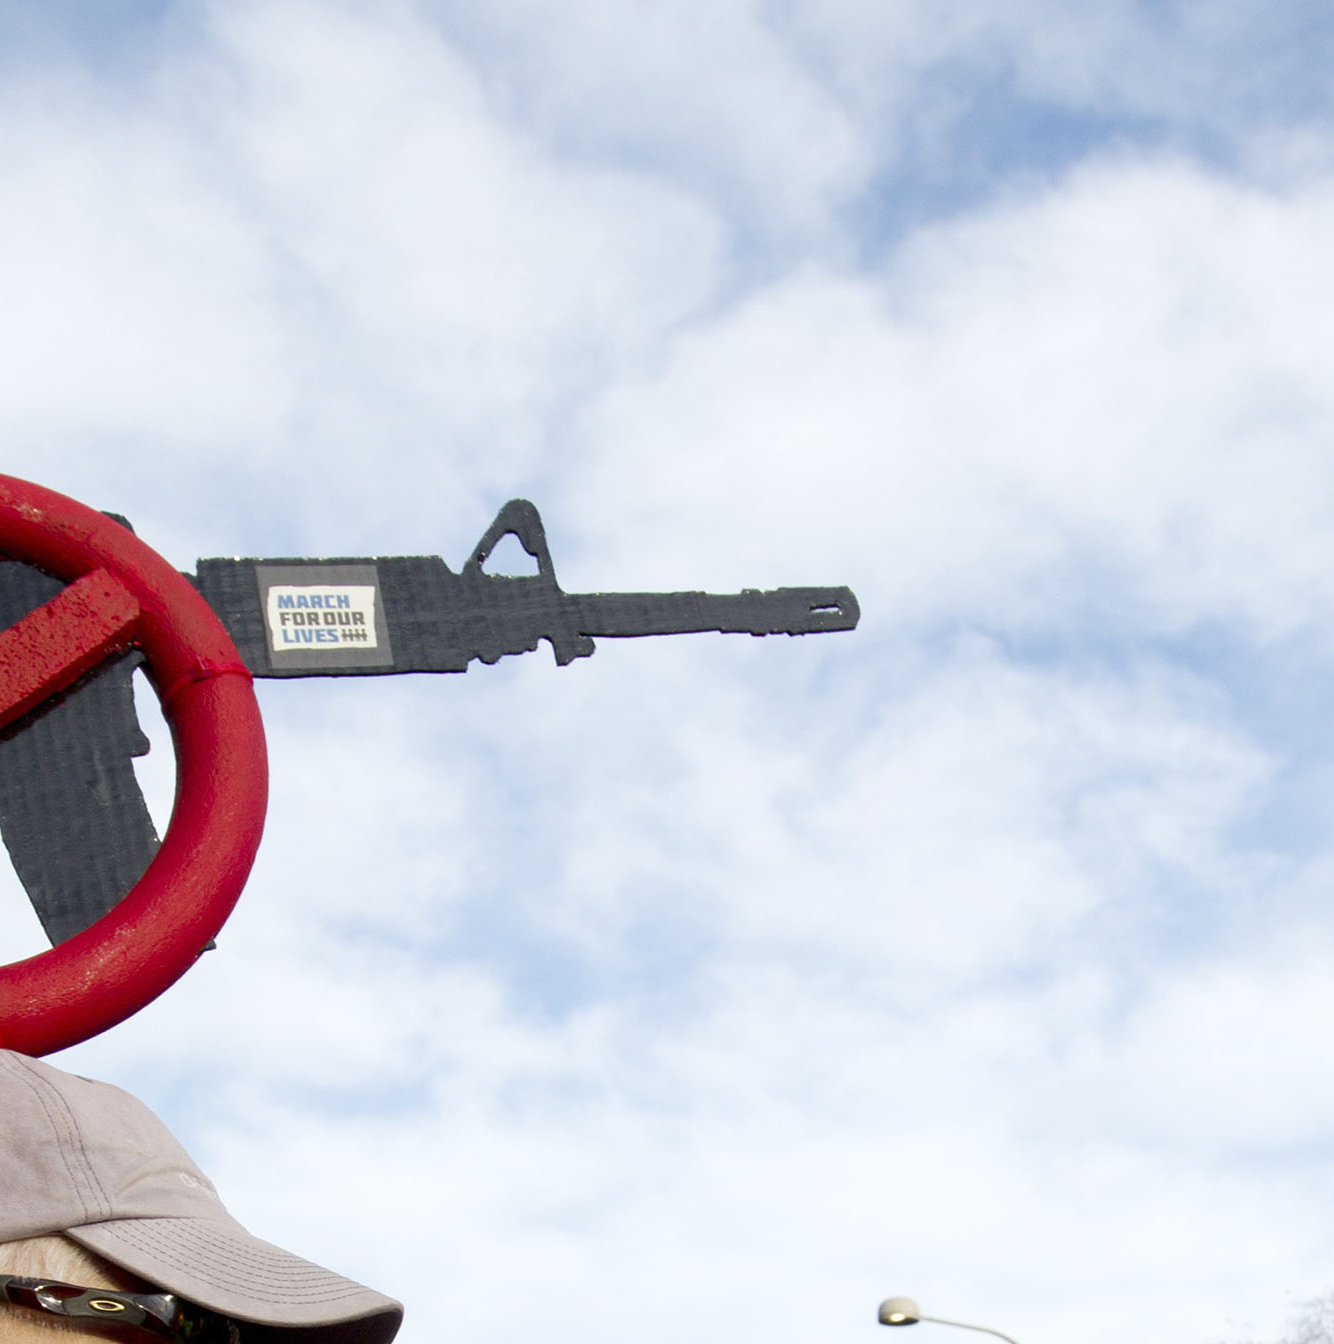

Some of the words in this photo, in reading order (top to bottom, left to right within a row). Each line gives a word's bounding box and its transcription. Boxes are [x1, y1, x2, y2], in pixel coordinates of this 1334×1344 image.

[277, 594, 351, 609] MARCH
[279, 611, 320, 626] FOR
[323, 611, 365, 626] OUR
[282, 628, 340, 643] LIVES
